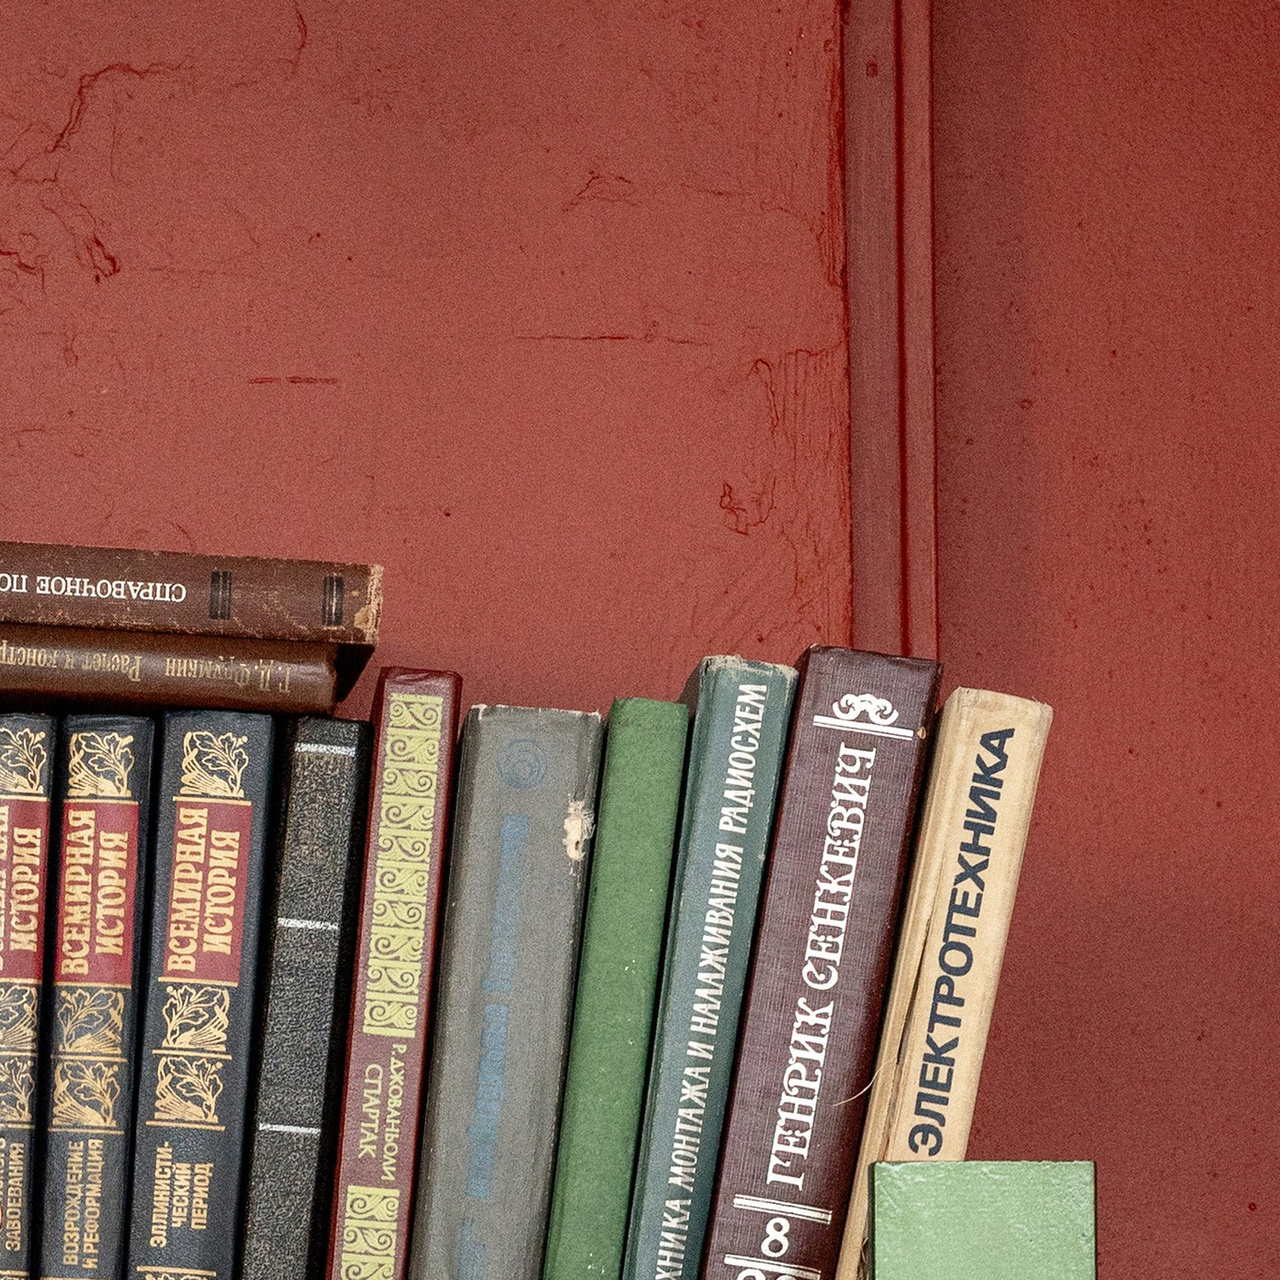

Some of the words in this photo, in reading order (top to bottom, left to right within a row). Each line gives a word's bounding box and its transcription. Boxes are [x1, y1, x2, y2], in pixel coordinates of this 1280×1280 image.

[37, 577, 187, 603] СПРАВОЧНОЕ
[85, 652, 141, 682] Расчет
[721, 683, 768, 835] РАДИОСХЕМ
[9, 826, 42, 952] ИСТОРИЯ
[61, 808, 97, 976] ВСЕМИРНАЯ
[95, 830, 129, 955] ИСТОРИЯ
[167, 807, 210, 973] ВСЕМИРНАЯ
[203, 830, 241, 955] ИСТОРИЯ
[689, 842, 745, 1037] НАЛАЖИВАНИЯ
[908, 727, 1015, 1156] ЭЛЕКТРОТЕХНИКА
[766, 996, 834, 1191] ГЕНРИК
[801, 741, 877, 992] СЕНКЕВИЧ
[355, 1063, 383, 1158] СПАРТАК
[669, 1064, 711, 1194] МОНТАЖА
[5, 1142, 27, 1252] ЗАВОЕВАНИЯ
[63, 1139, 85, 1266] ВОЗРОЖДЕНИЕ
[84, 1138, 105, 1257] РЕФОРМАЦИЯ
[150, 1141, 175, 1248] ЭЛЛИНИСТИ-
[171, 1161, 192, 1228] ЧЕСКИЙ
[190, 1161, 214, 1230] ПЕРИОД
[760, 1216, 790, 1258] 8
